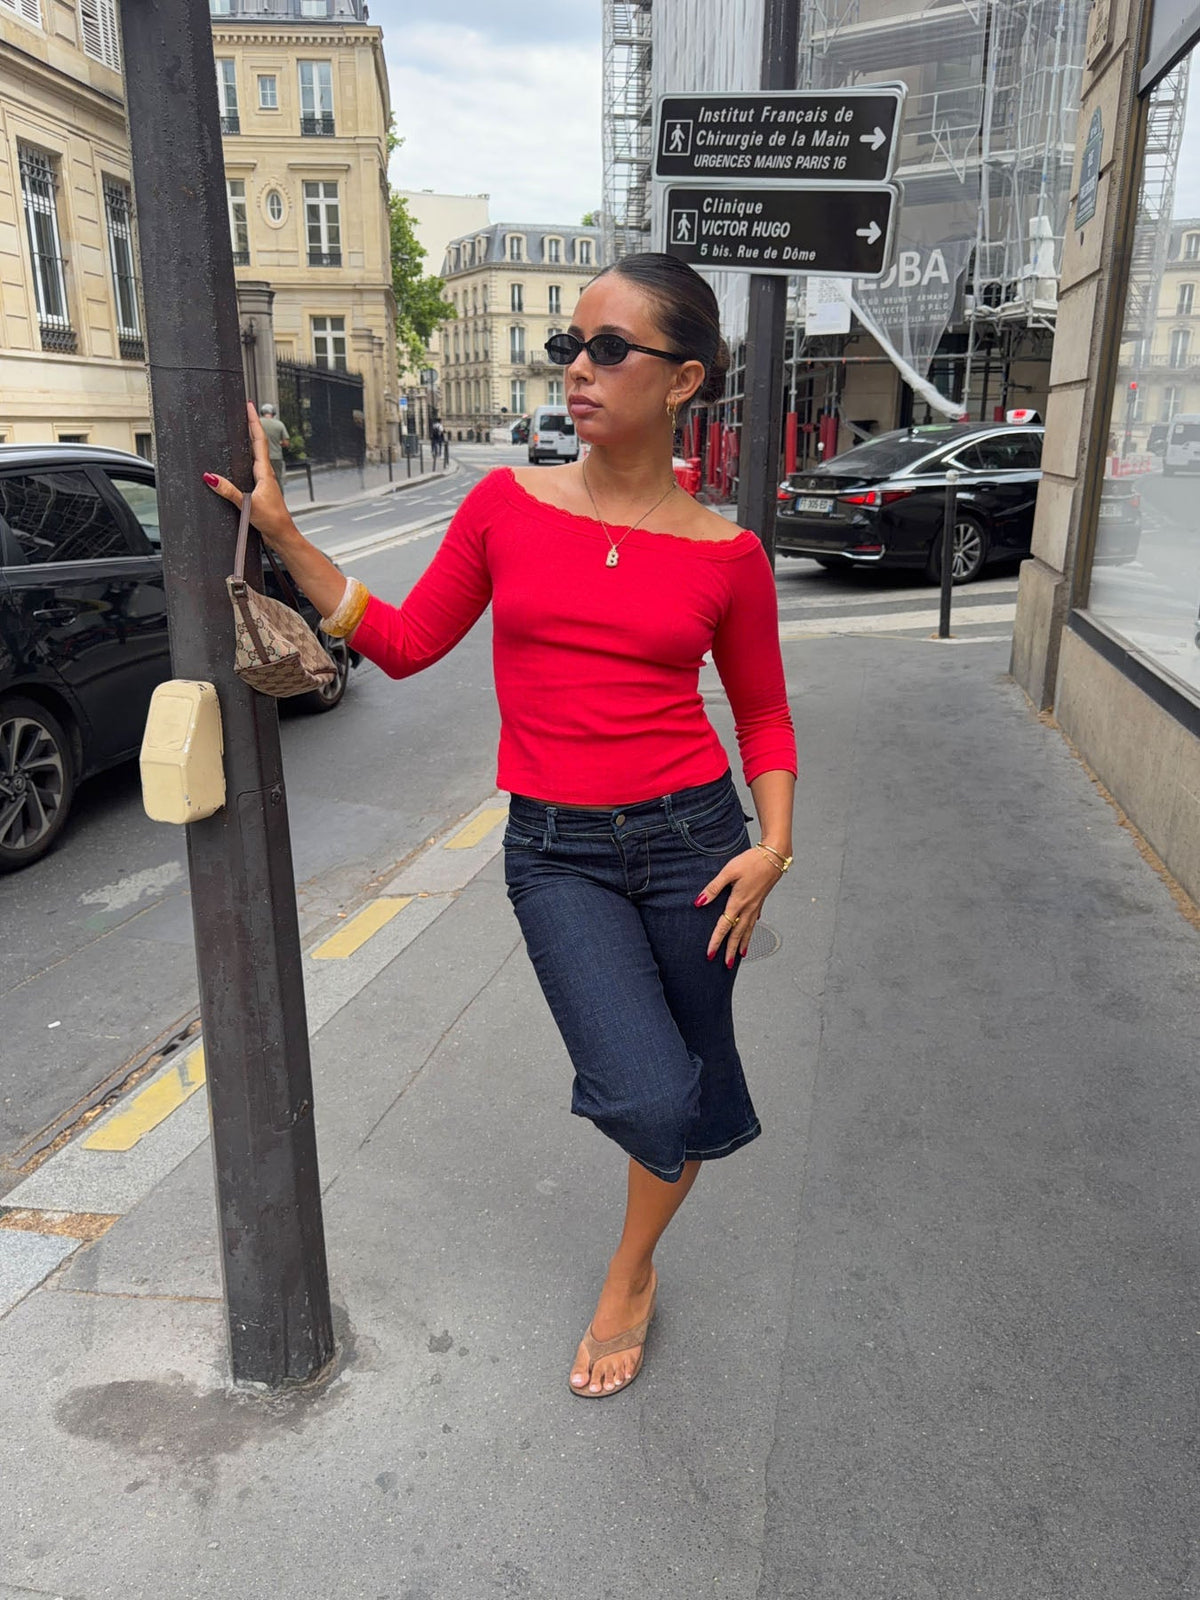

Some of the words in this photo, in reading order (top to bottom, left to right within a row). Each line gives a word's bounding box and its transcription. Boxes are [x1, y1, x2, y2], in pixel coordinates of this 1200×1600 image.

[698, 107, 755, 123] Institut
[760, 106, 828, 124] Français
[834, 106, 853, 123] de
[696, 130, 763, 150] Chirurgie
[768, 130, 786, 146] de
[791, 130, 806, 147] la
[811, 130, 850, 147] Main
[693, 154, 752, 168] URGENCES
[754, 155, 793, 169] MAINS
[795, 156, 831, 170] PARIS
[833, 156, 848, 170] 16
[702, 197, 763, 218] Clinique
[701, 220, 748, 237] VICTOR
[751, 221, 791, 238] HUGO
[700, 243, 708, 256] 5
[712, 244, 732, 257] bis.
[737, 244, 760, 258] Rue
[763, 246, 777, 259] de
[782, 246, 816, 261] Dôme
